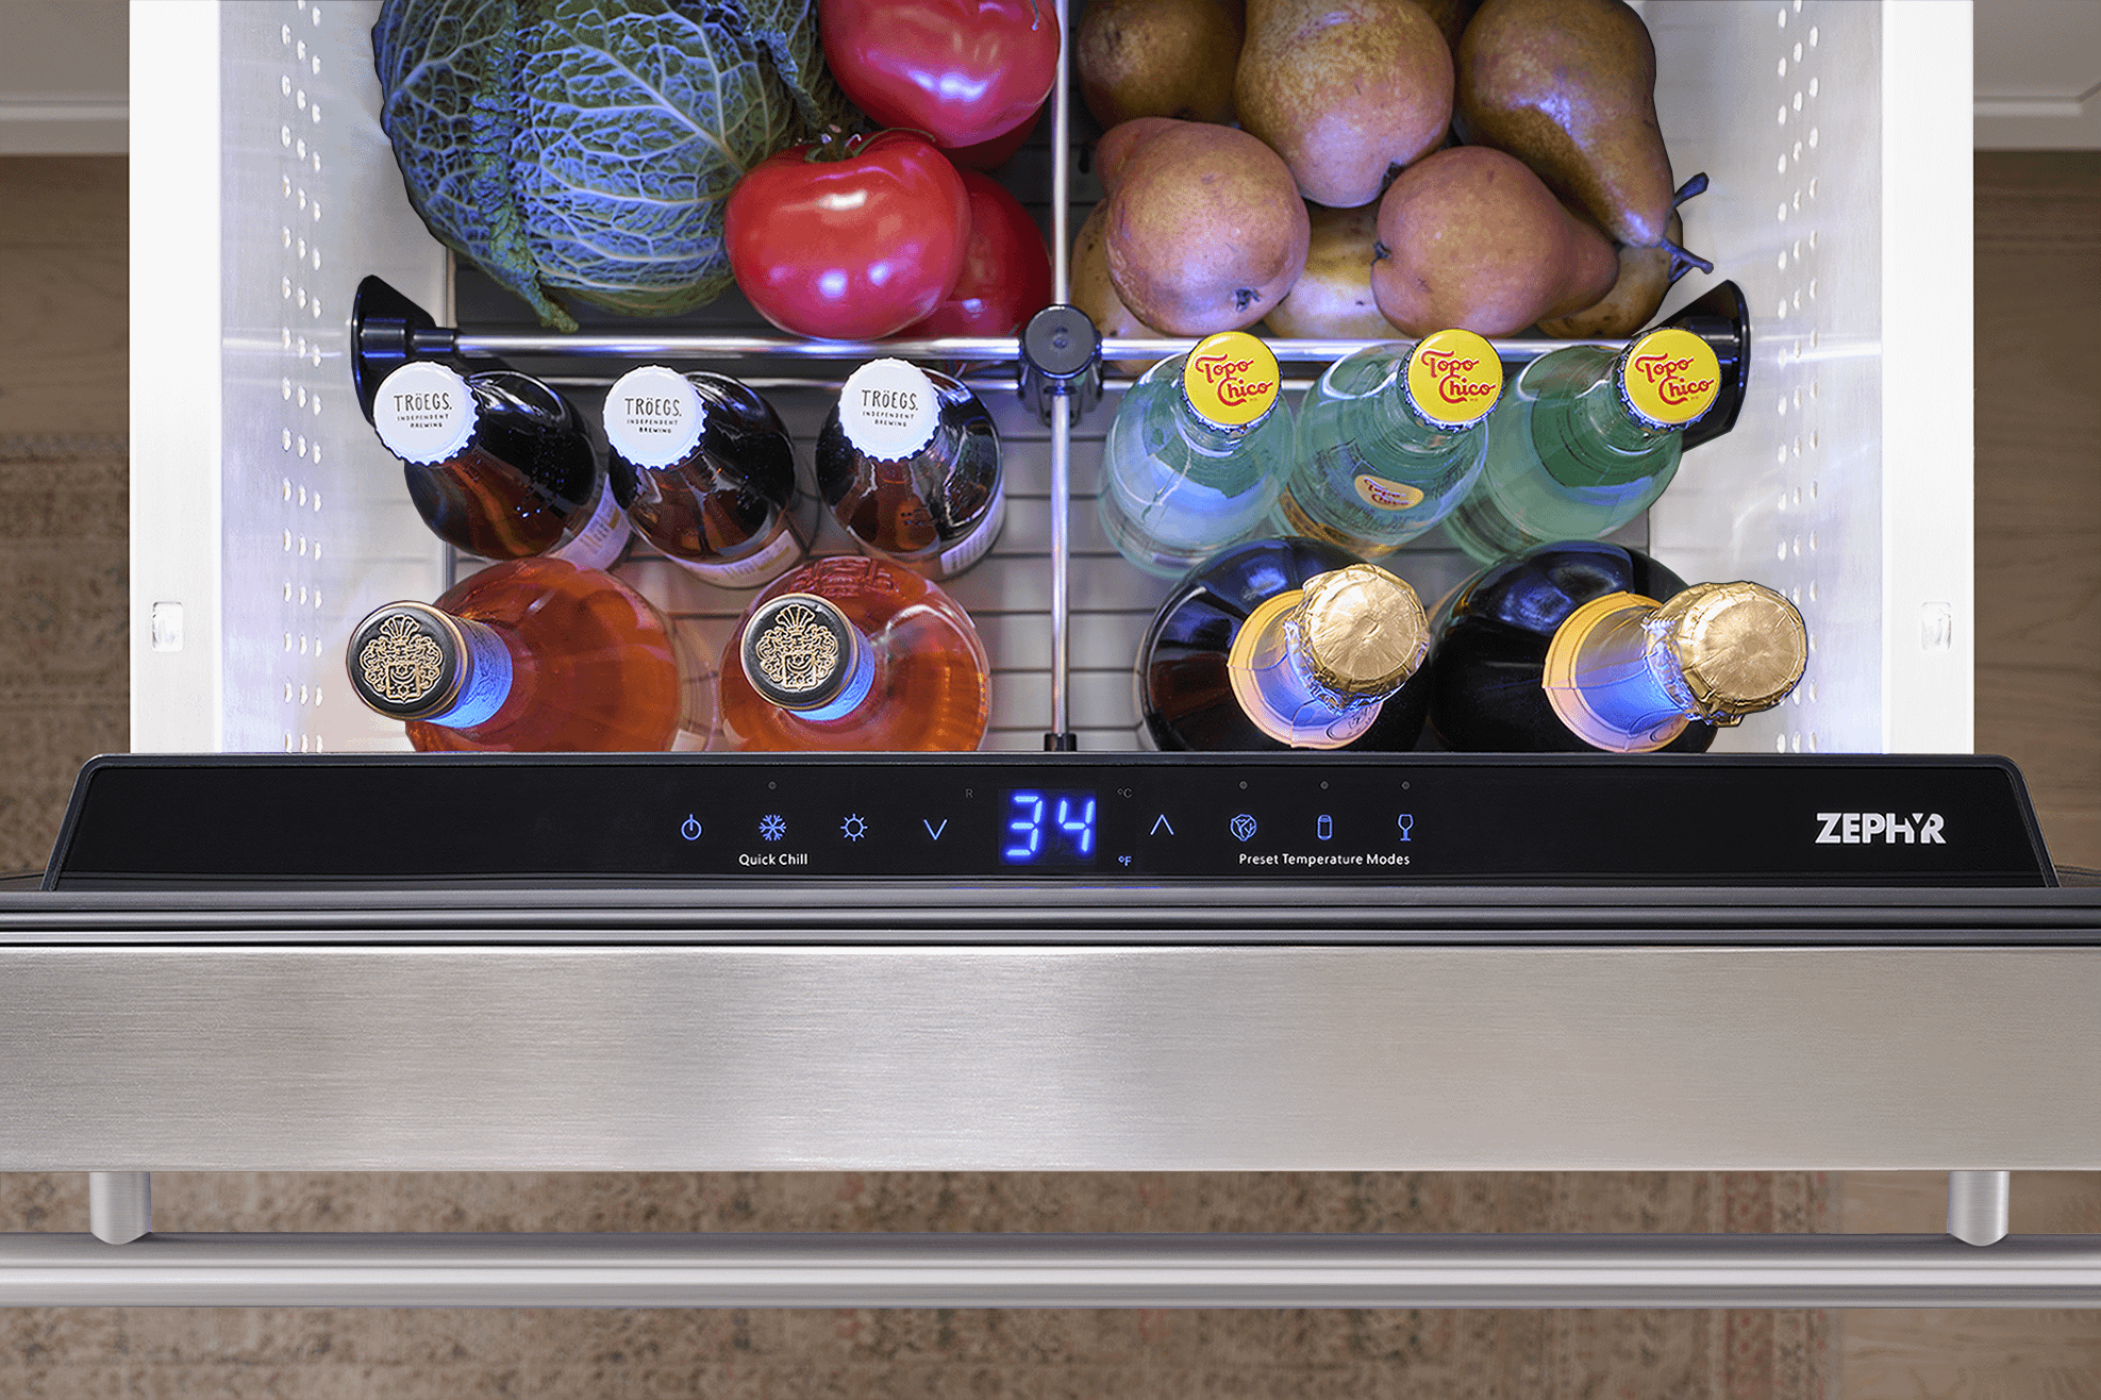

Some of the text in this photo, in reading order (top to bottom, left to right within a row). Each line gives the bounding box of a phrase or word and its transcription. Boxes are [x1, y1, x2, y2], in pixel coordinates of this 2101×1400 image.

[1195, 354, 1254, 384] Topo
[1421, 350, 1480, 378] Topo
[1635, 353, 1695, 384] Topo
[1217, 377, 1274, 407] Chico
[1439, 373, 1497, 404] Chico
[1658, 375, 1715, 406] Chico
[397, 413, 450, 422] INDEPENDENT
[410, 421, 443, 429] BREWING
[626, 418, 679, 426] INDEPENDENT
[862, 410, 915, 420] INDEPENDENT
[874, 418, 908, 428] BREWING
[639, 427, 672, 435] BREWING
[1006, 795, 1095, 857] 34
[1814, 812, 1947, 845] ZEPHYR
[738, 853, 809, 867] Quick Chill
[1239, 853, 1411, 868] Preset Temperature Modes
